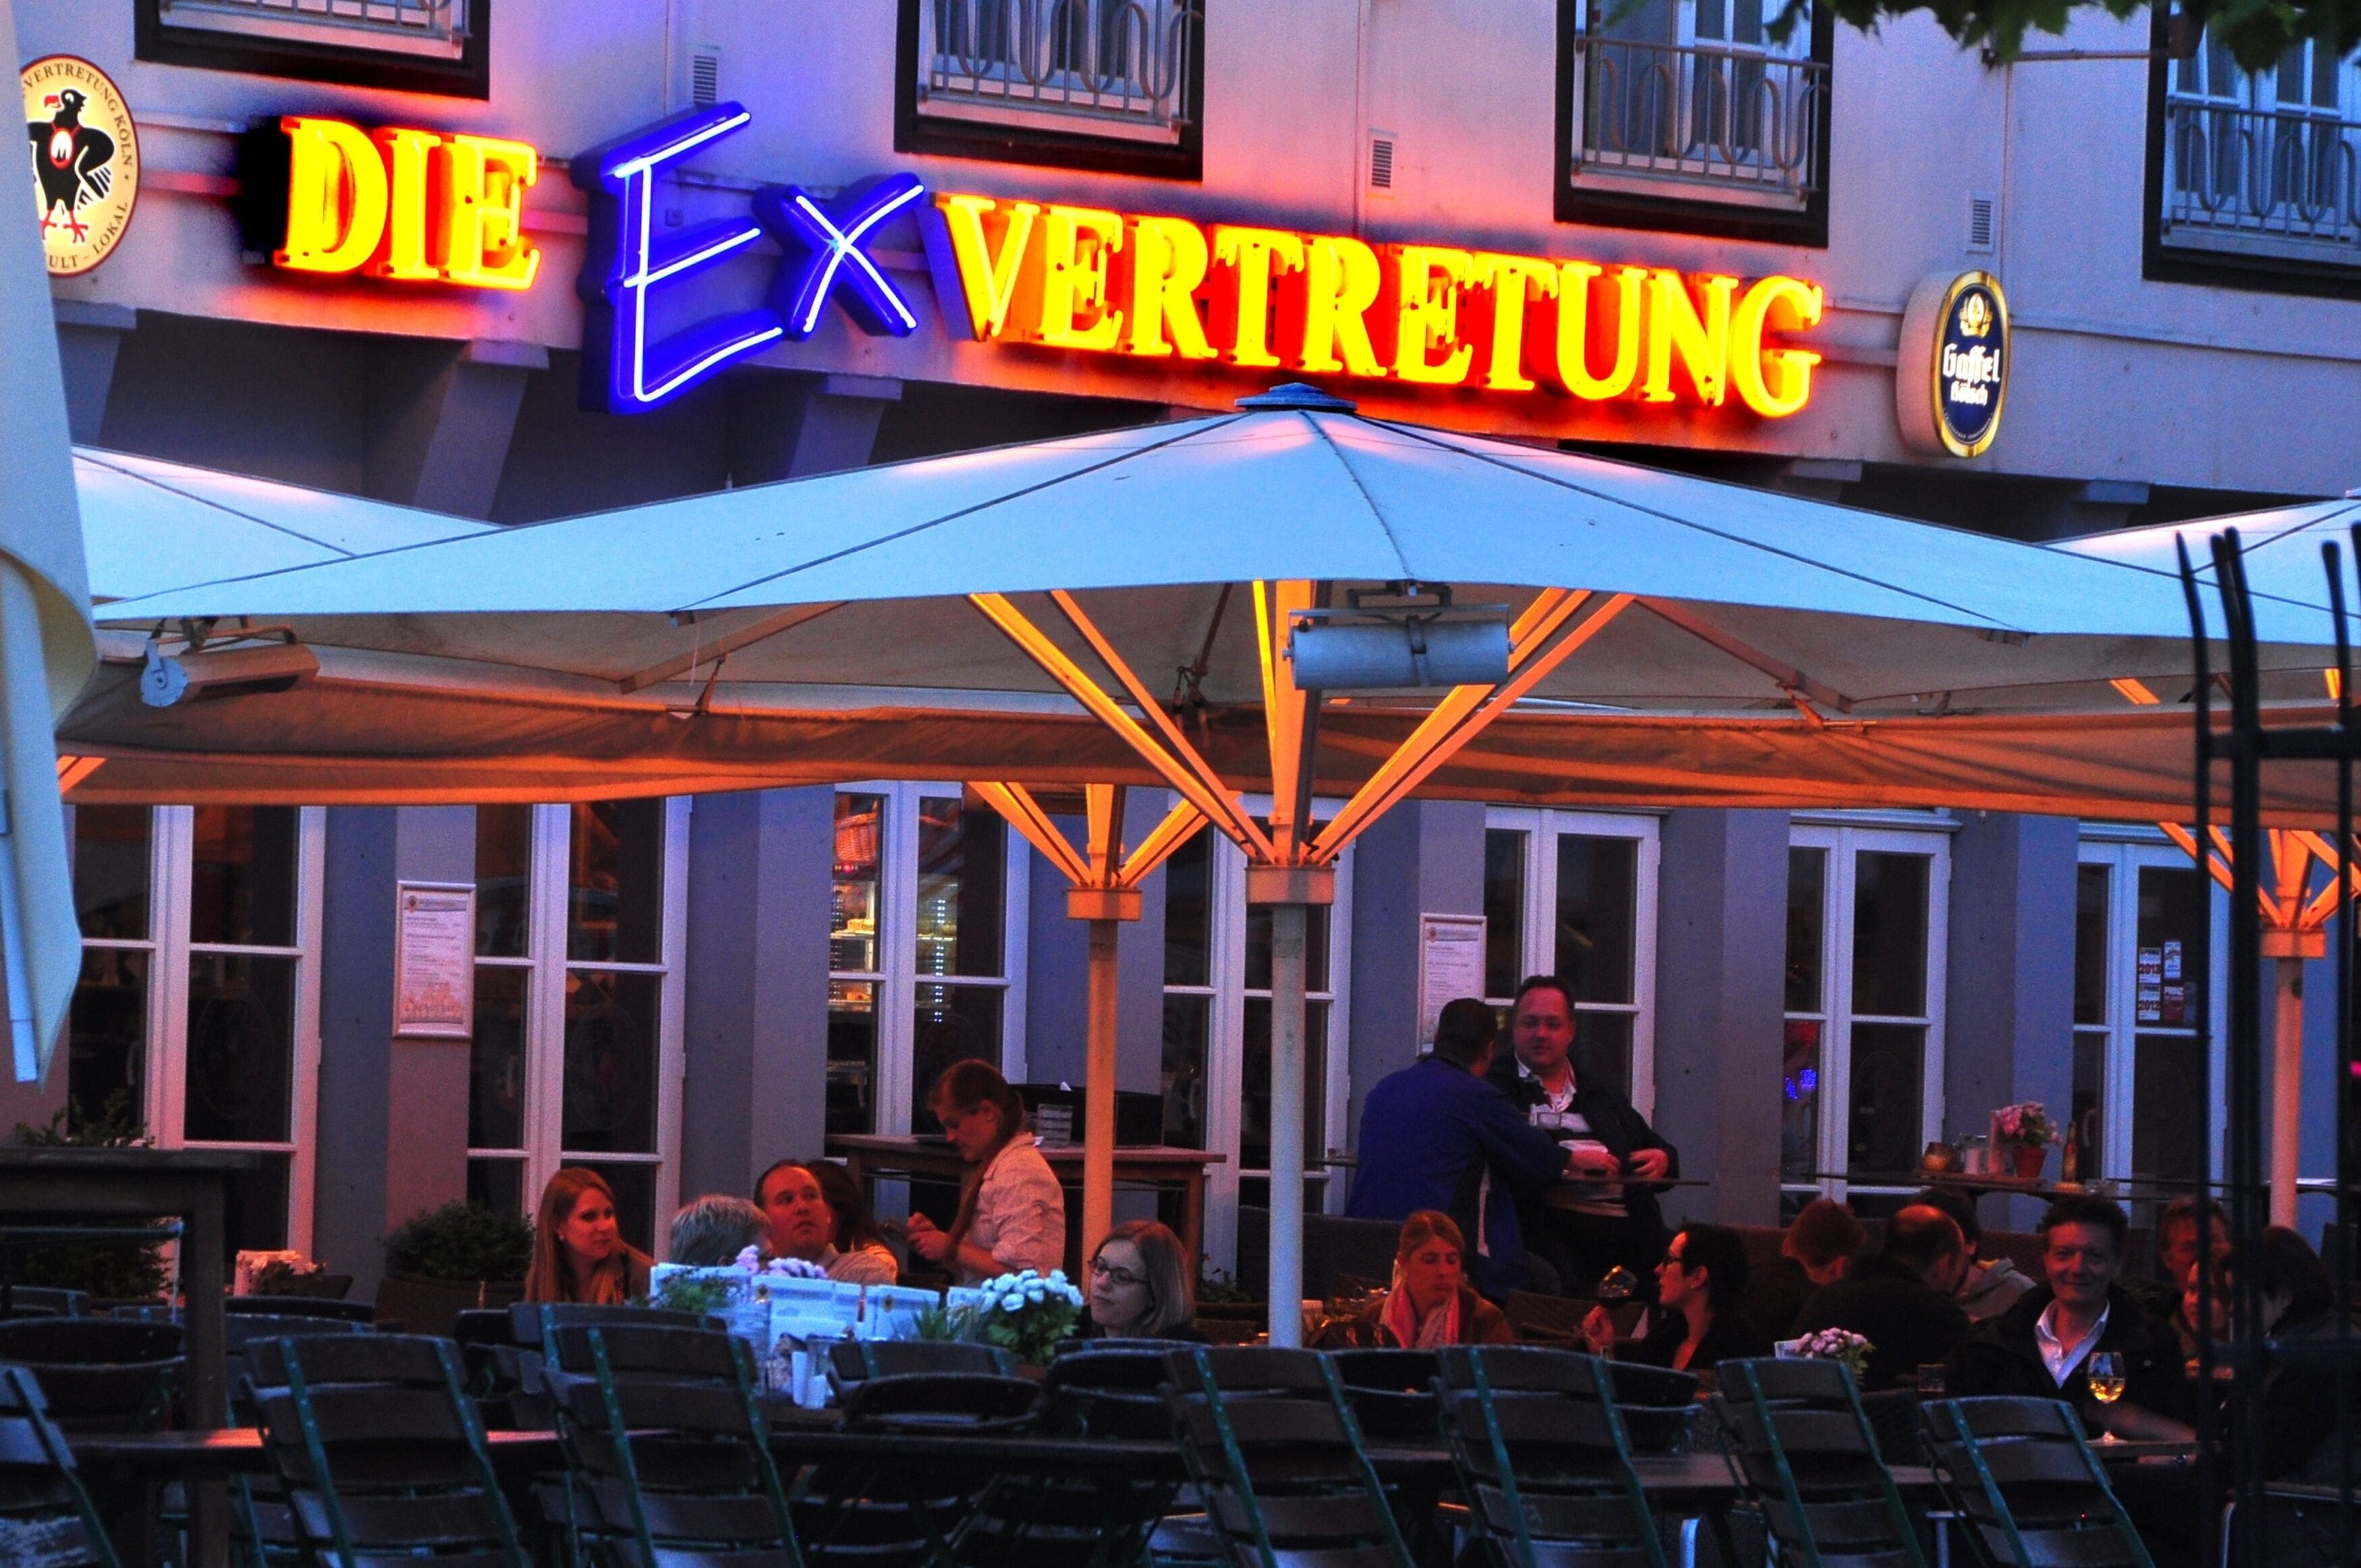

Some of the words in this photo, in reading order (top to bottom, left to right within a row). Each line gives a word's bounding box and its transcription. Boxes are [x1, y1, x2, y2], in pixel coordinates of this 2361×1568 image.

[113, 114, 134, 166] KÖLN
[46, 254, 78, 268] ULT
[92, 201, 128, 256] LOKAL
[275, 117, 541, 290] DIE
[936, 193, 1824, 418] VERTRETUNG
[1943, 343, 2000, 382] Gaffel
